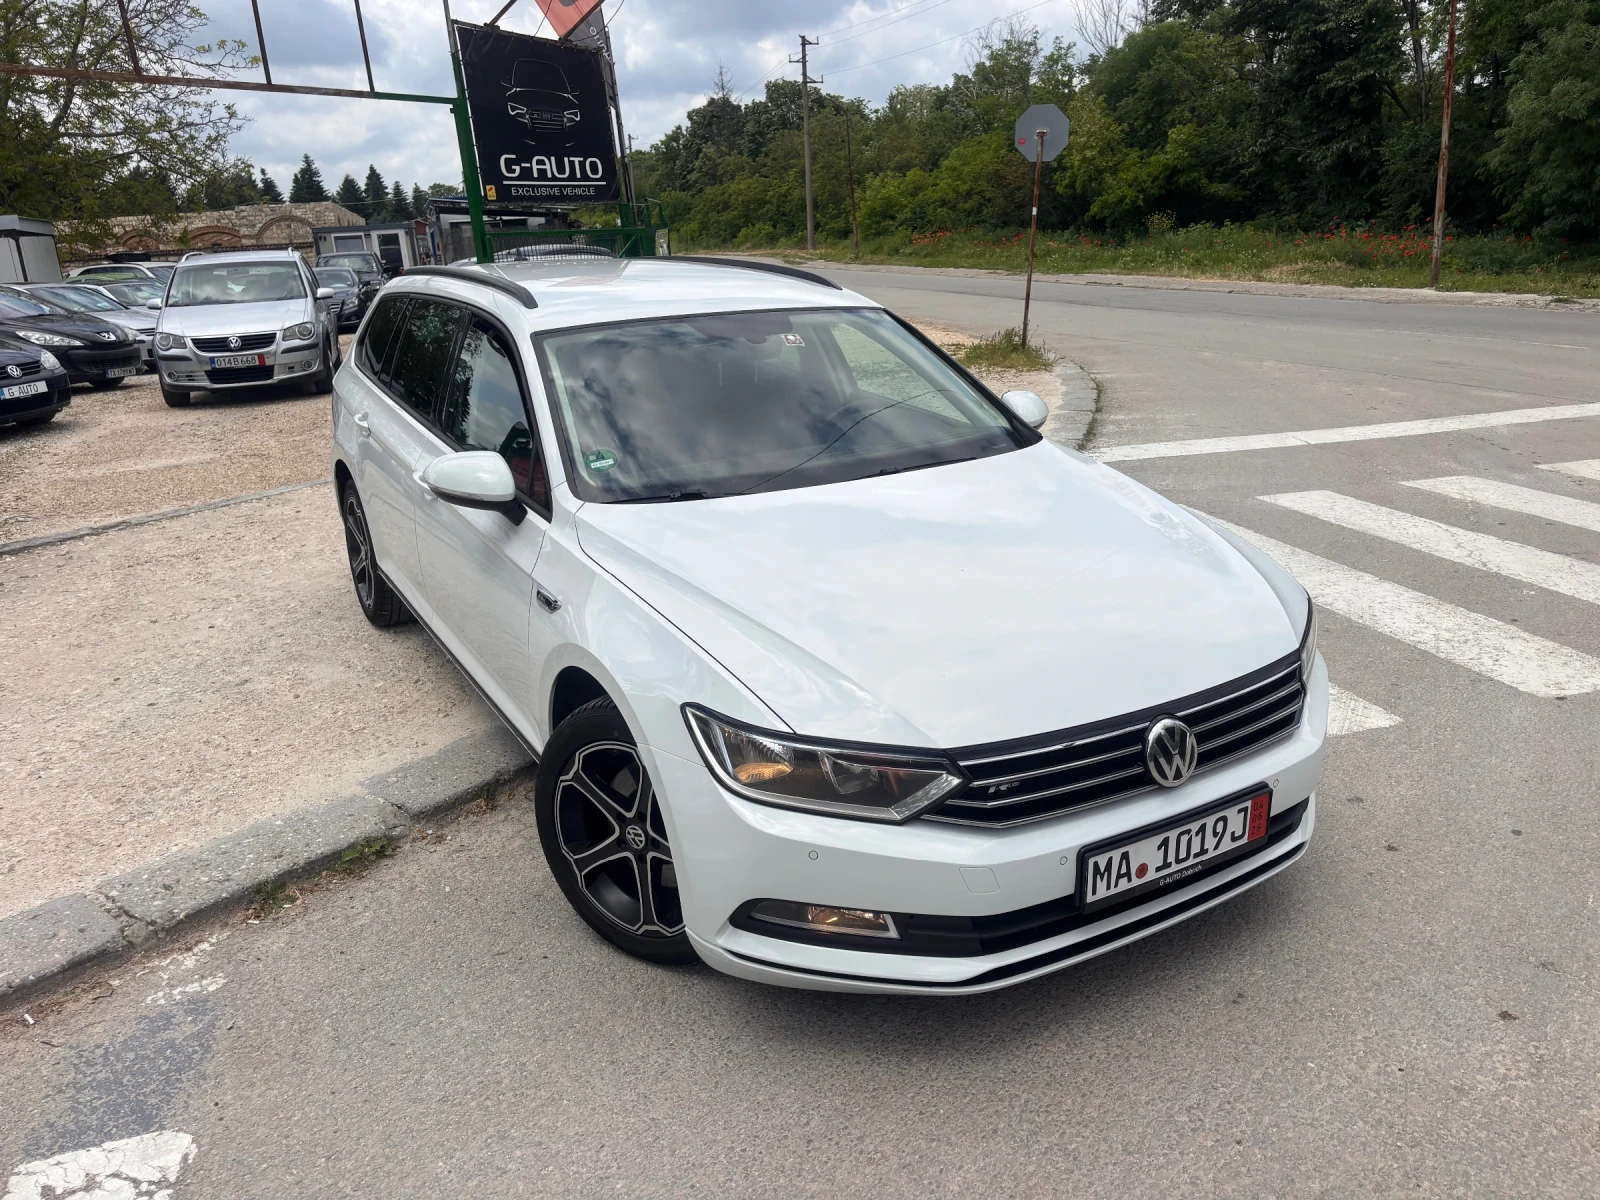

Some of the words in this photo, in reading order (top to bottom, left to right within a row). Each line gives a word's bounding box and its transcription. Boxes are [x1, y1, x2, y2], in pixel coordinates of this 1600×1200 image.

[500, 154, 603, 179] G-AUTO
[511, 187, 560, 196] EXCLUSIVE
[562, 187, 596, 196] VEHICLE
[7, 384, 39, 397] G-AUTO
[1092, 850, 1132, 896] MA
[1155, 806, 1249, 873] 1019J
[1159, 873, 1182, 886] G-AUTO
[1182, 864, 1202, 877] Dobrich
